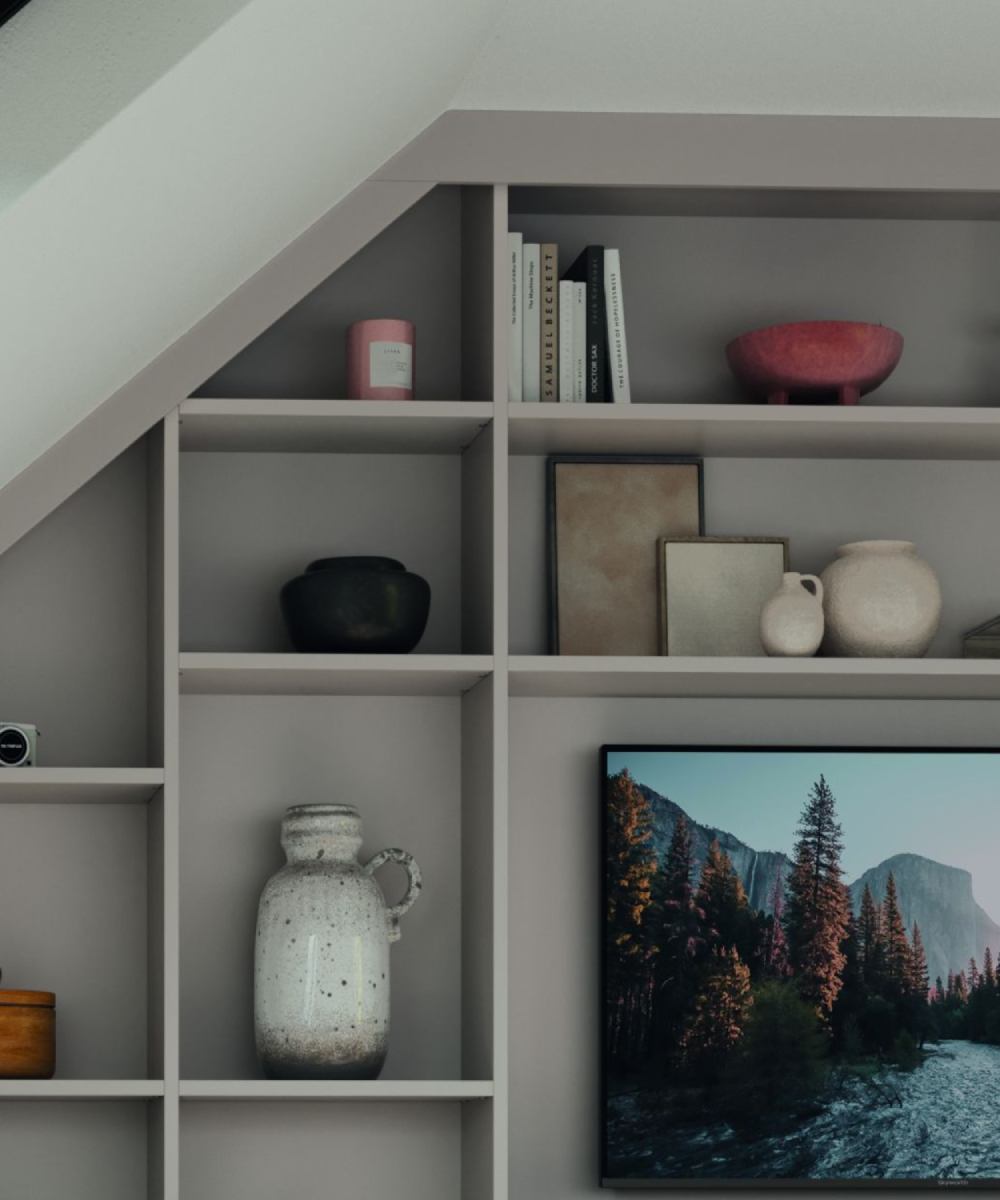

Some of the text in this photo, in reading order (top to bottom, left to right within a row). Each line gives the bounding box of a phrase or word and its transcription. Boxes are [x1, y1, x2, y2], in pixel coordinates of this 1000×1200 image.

[545, 253, 553, 396] SAMUEL BECKETT
[611, 273, 619, 327] HOPELESSNESS
[615, 329, 620, 337] OF
